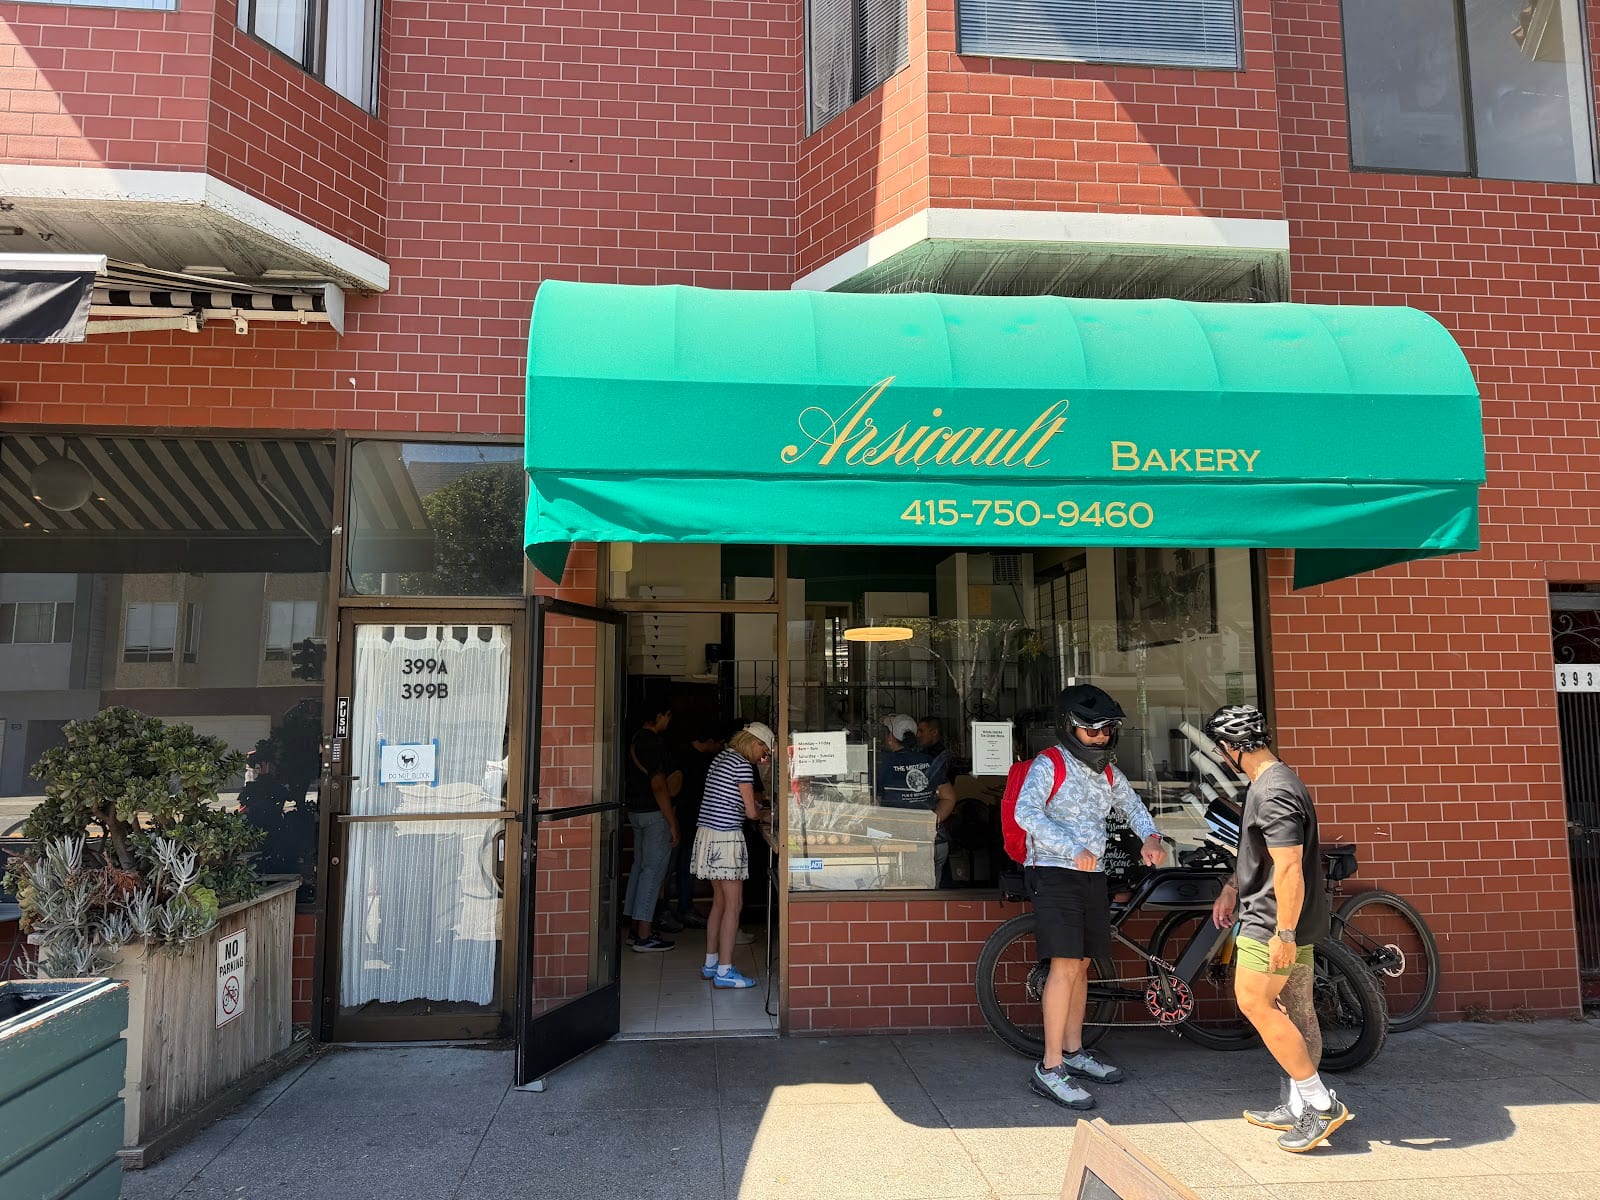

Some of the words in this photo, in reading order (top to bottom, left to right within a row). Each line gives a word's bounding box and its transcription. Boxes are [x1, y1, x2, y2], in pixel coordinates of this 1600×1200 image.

[780, 375, 1070, 469] Arsicault
[900, 499, 1154, 529] 415-750-9460
[401, 658, 448, 675] 399A
[1560, 671, 1593, 687] 393
[401, 683, 449, 699] 399B
[338, 700, 347, 735] PUSH
[225, 939, 239, 961] NO
[219, 957, 243, 978] PARKING
